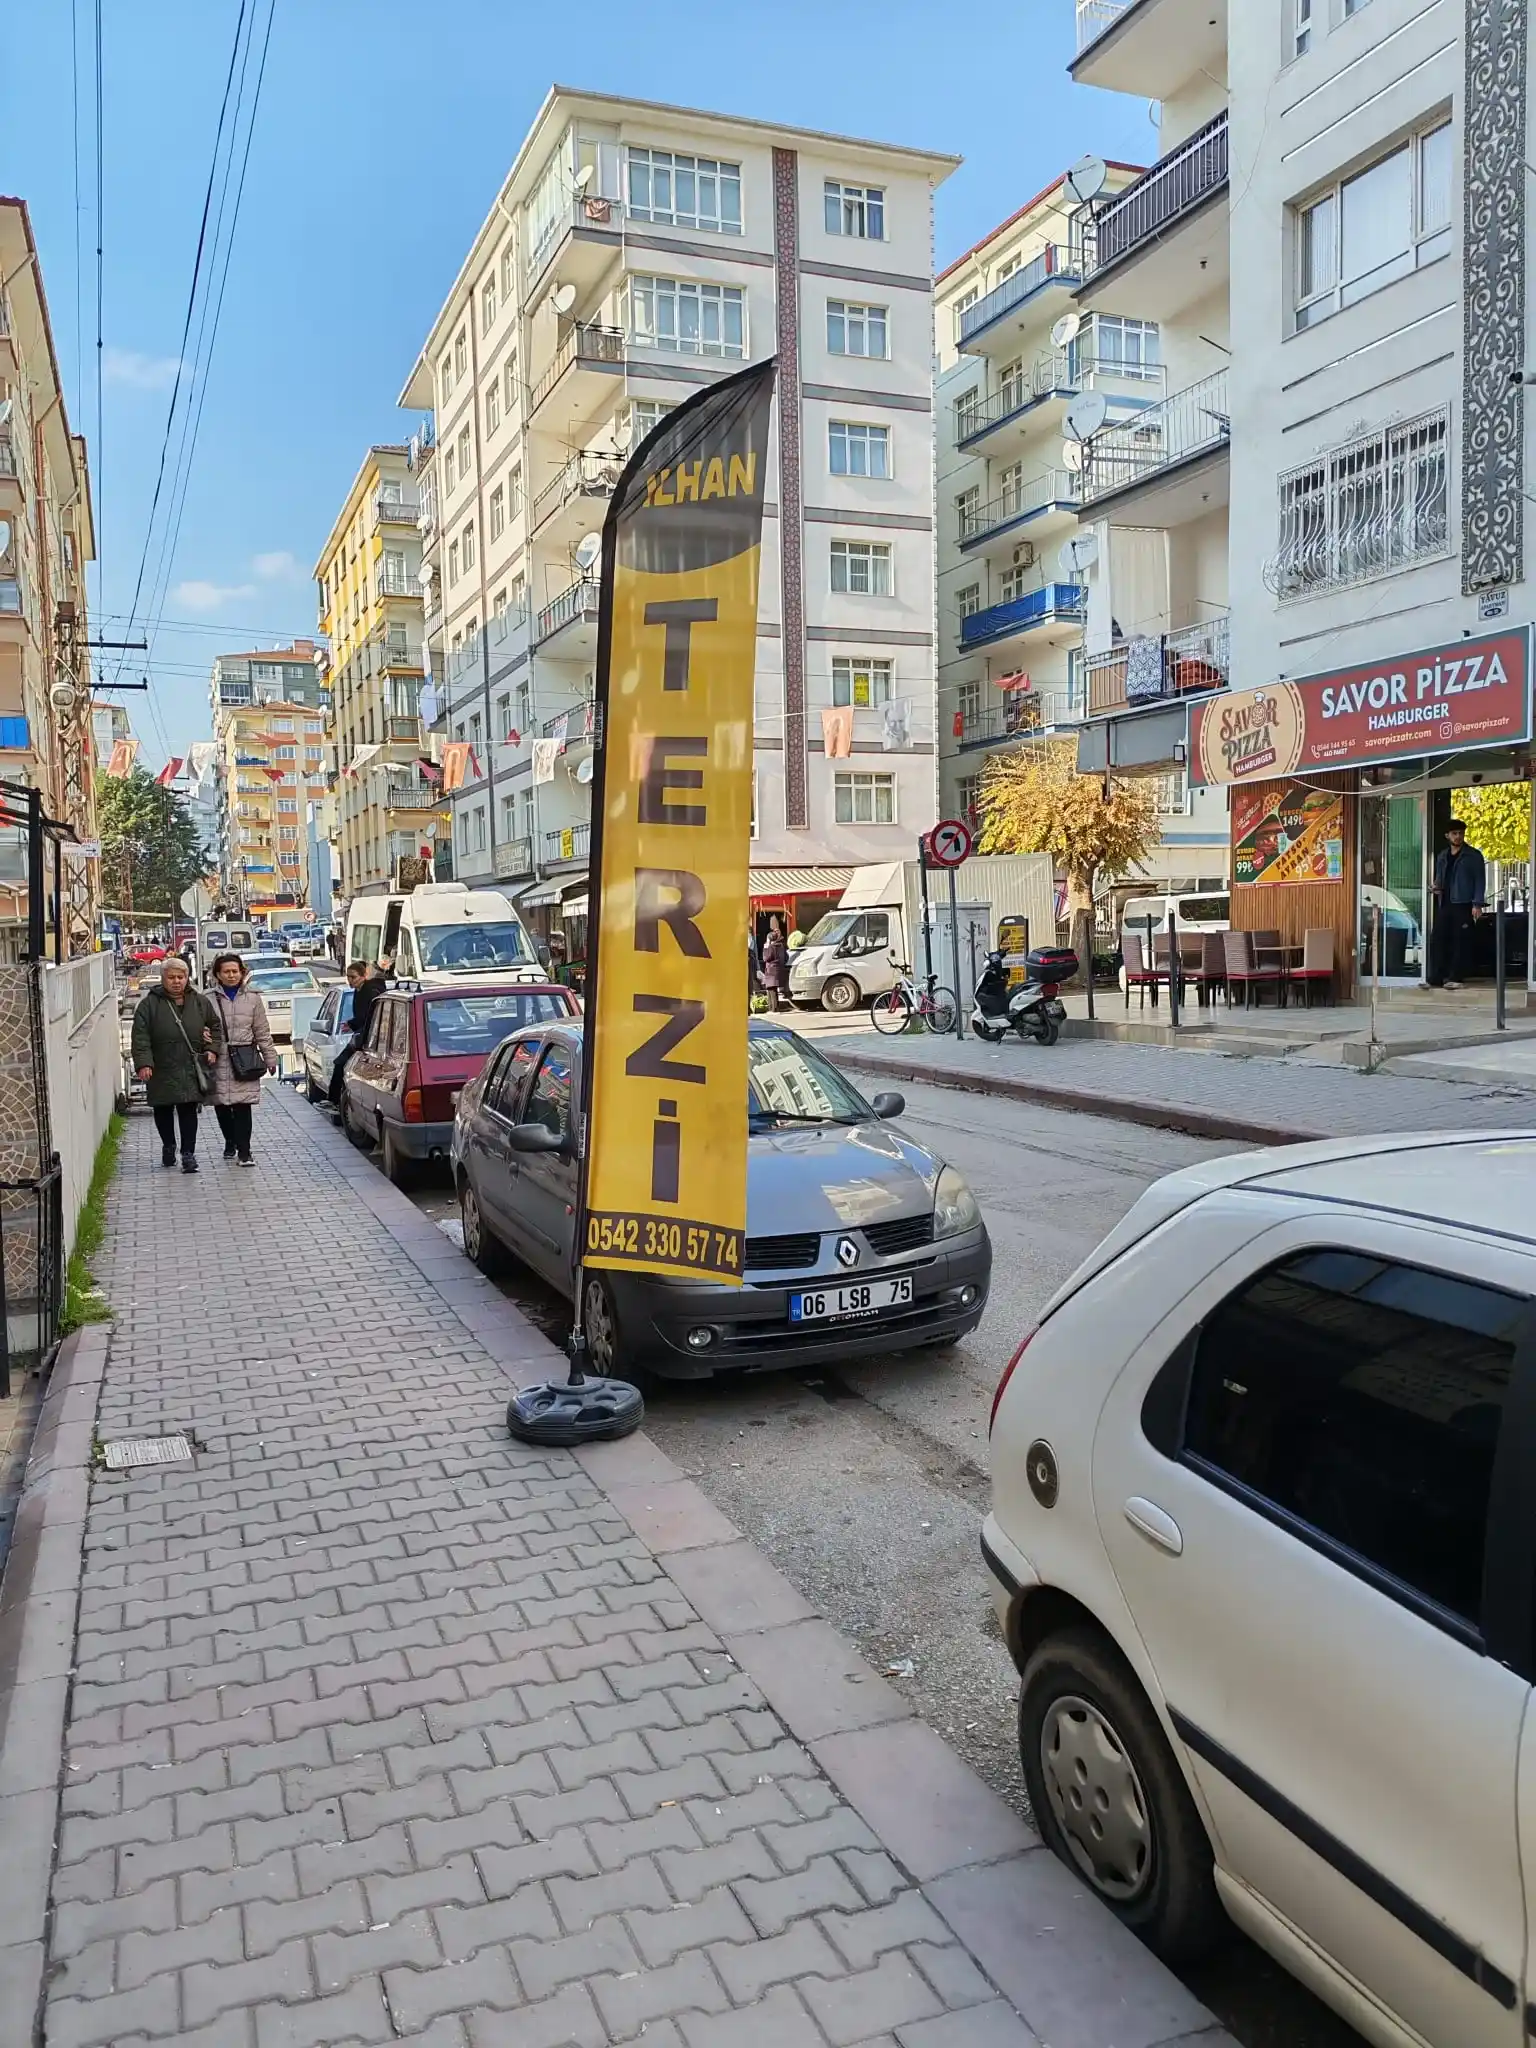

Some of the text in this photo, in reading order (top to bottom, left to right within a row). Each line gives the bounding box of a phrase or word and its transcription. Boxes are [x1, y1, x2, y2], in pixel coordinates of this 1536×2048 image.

[1321, 651, 1508, 719] SAVOR PİZZA
[1368, 703, 1449, 731] HAMBURGER
[1365, 728, 1432, 748] savorpizzatr.com
[1235, 752, 1273, 772] HAMBURGER
[588, 1217, 738, 1268] 0542 330 57 74
[803, 1293, 826, 1316] 06
[838, 1286, 871, 1312] LSB
[889, 1279, 910, 1303] 75
